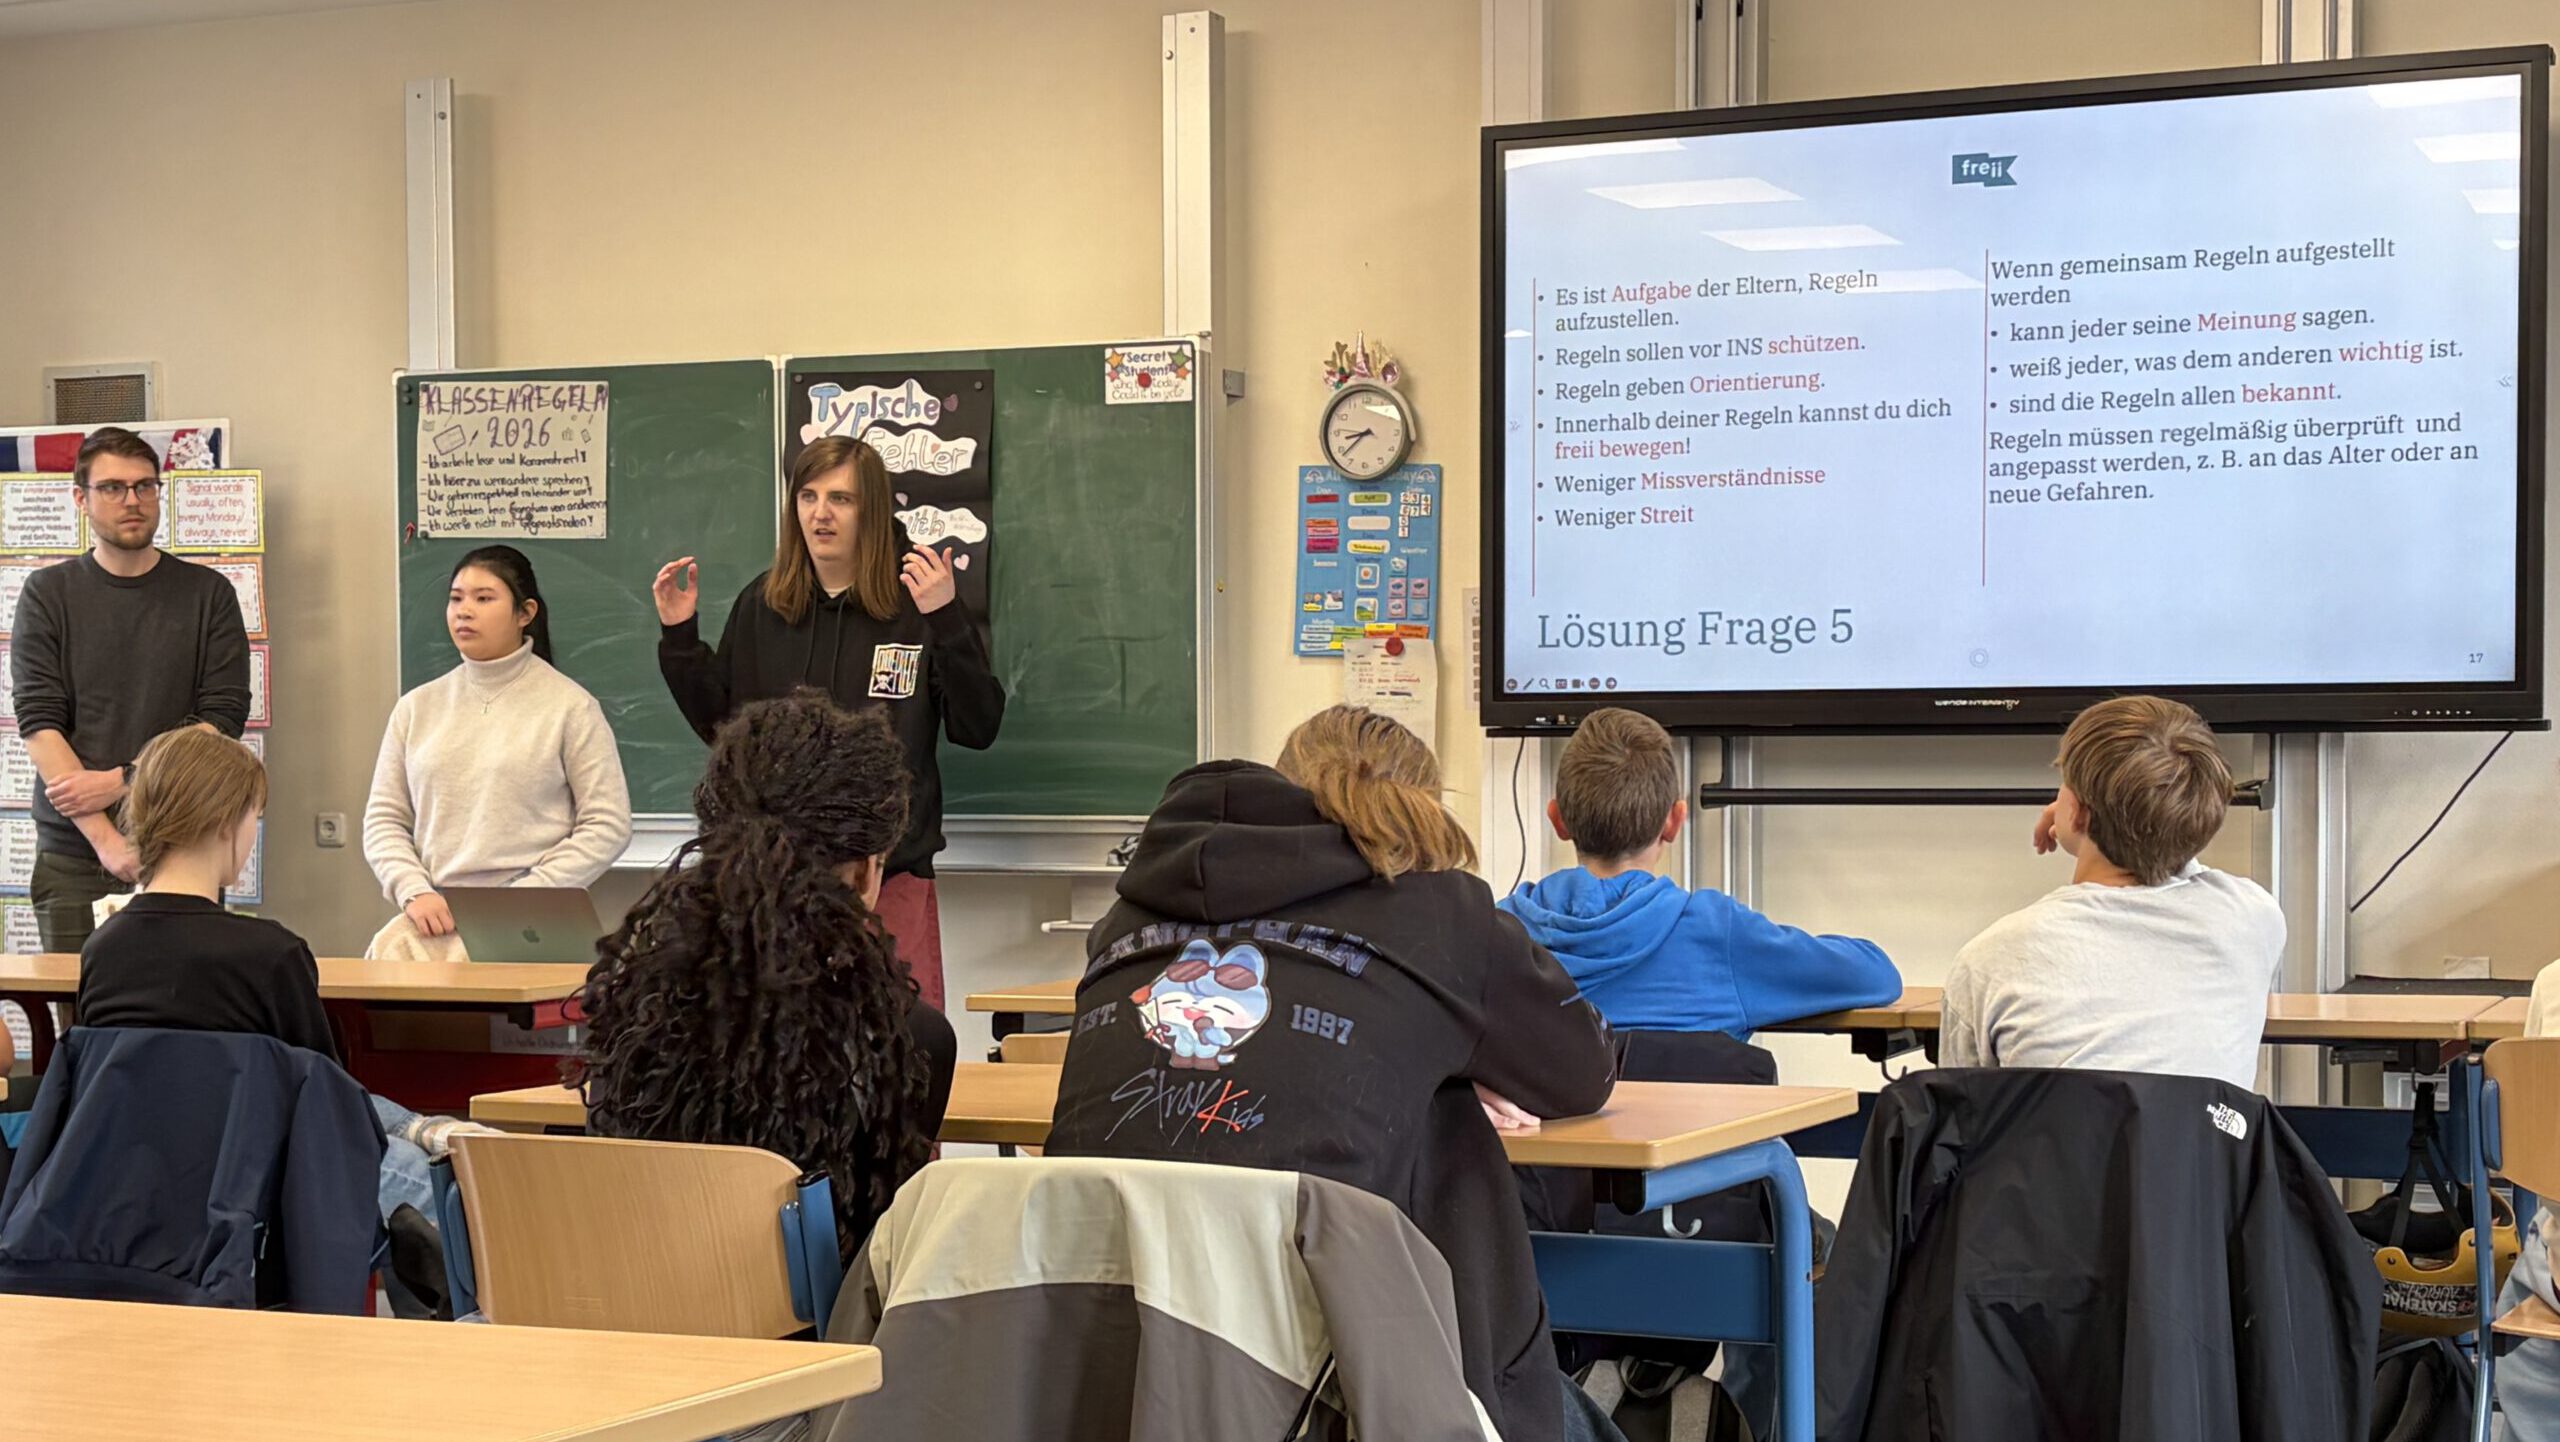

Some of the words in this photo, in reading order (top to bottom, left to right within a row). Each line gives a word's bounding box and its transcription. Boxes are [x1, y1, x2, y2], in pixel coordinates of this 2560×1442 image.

[1961, 159, 2002, 178] freii
[1991, 261, 2053, 279] Wenn
[2060, 253, 2187, 280] gemeinsam
[2193, 245, 2270, 271] Regeln
[2276, 238, 2395, 266] aufgestellt
[1556, 288, 1578, 306] Es
[1583, 286, 1606, 304] ist
[1611, 281, 1692, 304] Aufgabe
[1697, 278, 1730, 297] der
[1736, 275, 1803, 295] Eltern,
[1808, 269, 1878, 294] Regeln
[1990, 285, 2071, 307] werden
[1555, 309, 1679, 332] aufzustellen.
[2010, 323, 2065, 342] kann
[2069, 318, 2127, 343] jeder
[2132, 315, 2191, 336] seine
[2197, 311, 2297, 332] Meinung
[2302, 308, 2375, 330] sagen.
[1126, 351, 1166, 363] Secret
[1555, 345, 1620, 369] Regeln
[1626, 342, 1684, 362] sollen
[1689, 344, 1722, 359] vor
[1727, 337, 1763, 356] INS
[1768, 334, 1865, 354] schützen.
[2009, 356, 2061, 378] weiß
[2065, 354, 2128, 379] jeder,
[2134, 354, 2177, 372] was
[2183, 349, 2231, 370] dem
[2238, 346, 2333, 367] anderen
[2339, 340, 2423, 364] wichtig
[2429, 338, 2463, 359] ist.
[424, 383, 609, 415] KLASSENREGELN
[1555, 380, 1620, 403] Regeln
[1626, 378, 1685, 401] geben
[1690, 372, 1825, 394] Orientierung.
[2009, 392, 2056, 413] sind
[2061, 391, 2094, 411] die
[2100, 388, 2175, 413] Regeln
[2181, 385, 2235, 406] allen
[2242, 382, 2342, 403] bekannt.
[810, 379, 940, 438] Typische
[1555, 412, 1650, 434] Innerhalb
[1656, 410, 1720, 429] deiner
[1725, 406, 1793, 430] Regeln
[1799, 404, 1869, 423] kannst
[1874, 400, 1901, 419] du
[1906, 398, 1951, 418] dich
[487, 416, 552, 448] 2026
[1989, 429, 2062, 453] Regeln
[2068, 428, 2153, 447] müssen
[2160, 419, 2287, 446] regelmäßig
[2293, 414, 2404, 440] überprüft
[2416, 412, 2461, 433] und
[1555, 440, 1594, 459] freii
[1599, 437, 1690, 460] bewegen!
[1989, 456, 2097, 480] angepasst
[2102, 452, 2191, 473] werden,
[2197, 453, 2215, 469] z.
[2221, 450, 2242, 468] B.
[2249, 451, 2277, 467] an
[2283, 446, 2322, 466] das
[2328, 445, 2385, 465] Alter
[2391, 442, 2444, 462] oder
[2450, 444, 2478, 460] an
[1555, 473, 1636, 496] Weniger
[1641, 466, 1826, 490] Missverständnisse
[1989, 487, 2041, 504] neue
[2047, 481, 2154, 502] Gefahren.
[1555, 507, 1636, 529] Weniger
[1640, 505, 1694, 524] Streit
[1537, 613, 1686, 655] Lösung
[1698, 611, 1816, 653] Frage
[1830, 608, 1853, 643] 5
[2469, 653, 2484, 663] 17
[1290, 1003, 1355, 1045] 1997
[1104, 1067, 1222, 1147] Stray
[1196, 1080, 1267, 1134] Kids
[2382, 1289, 2458, 1313] SKATEHAL
